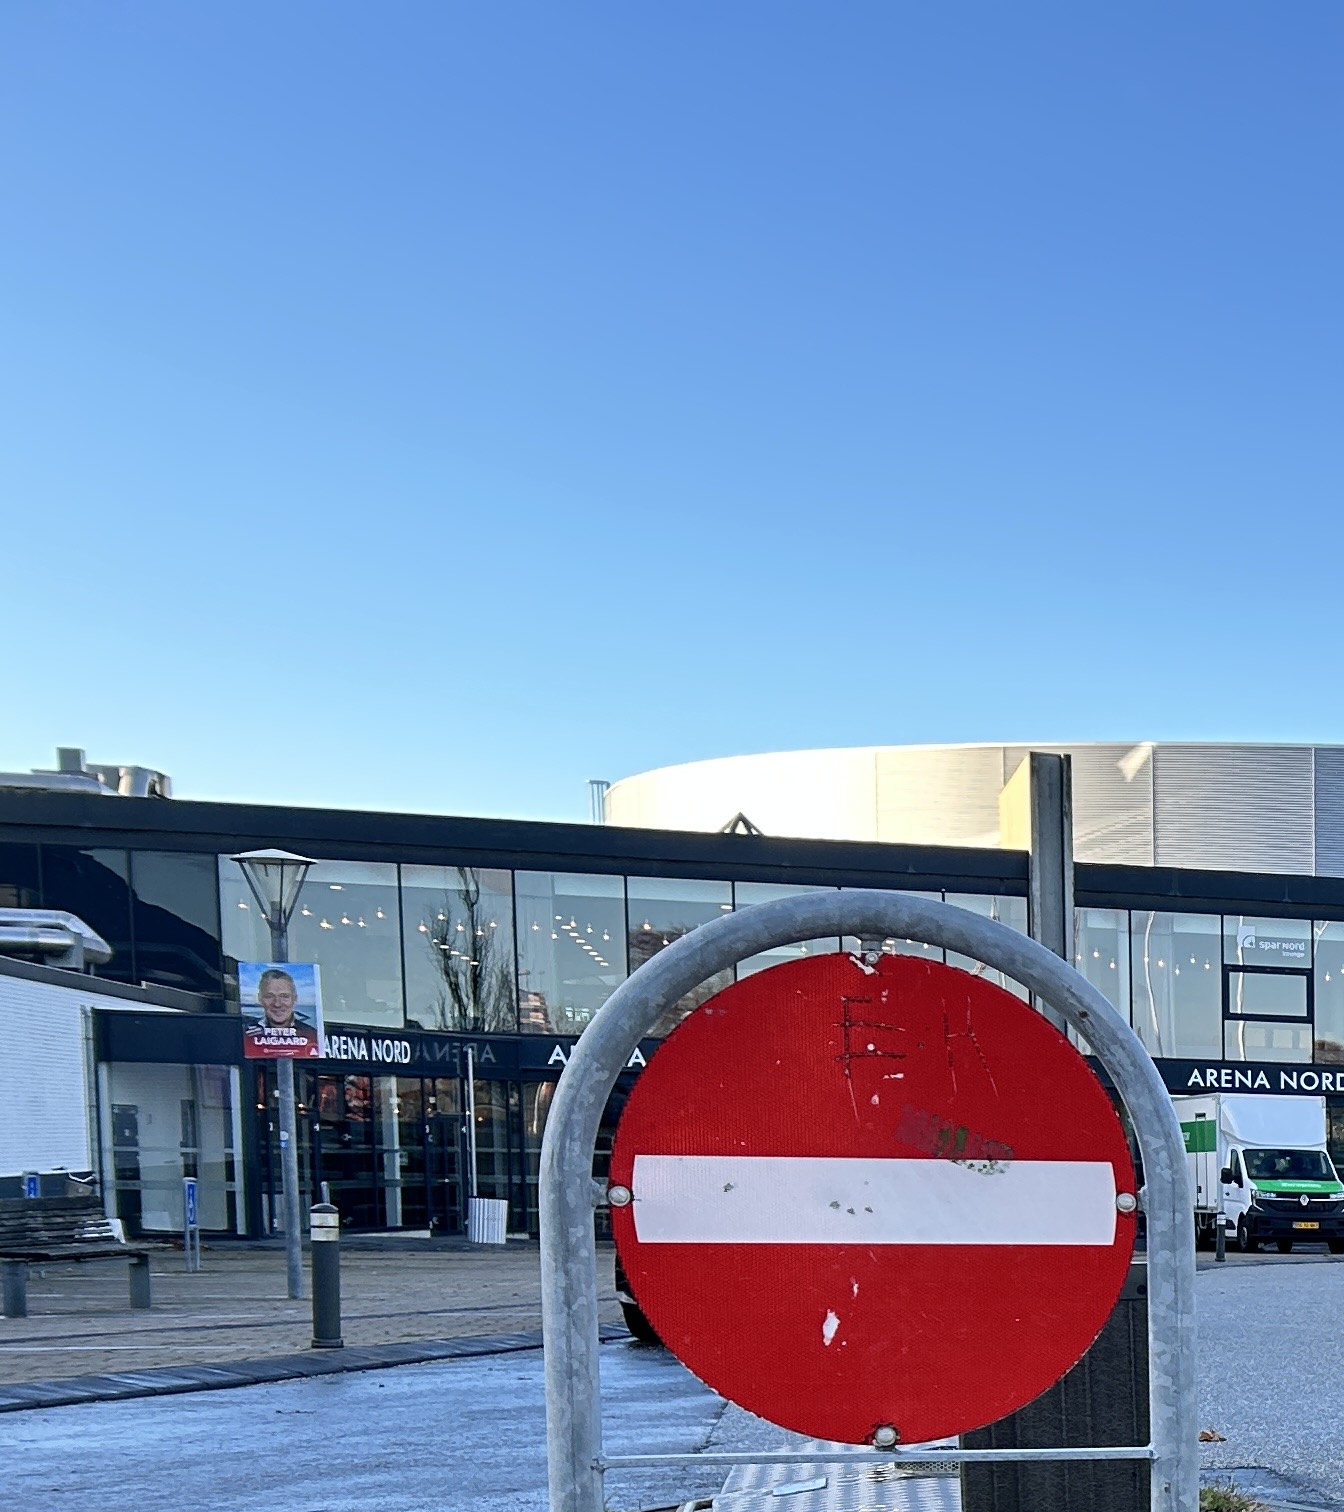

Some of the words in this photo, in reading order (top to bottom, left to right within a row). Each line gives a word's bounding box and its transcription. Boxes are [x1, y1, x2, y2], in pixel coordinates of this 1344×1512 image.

[264, 1027, 296, 1036] PETER
[324, 1035, 369, 1060] ARENA
[371, 1038, 411, 1064] NORD
[1187, 1068, 1271, 1089] ARENA
